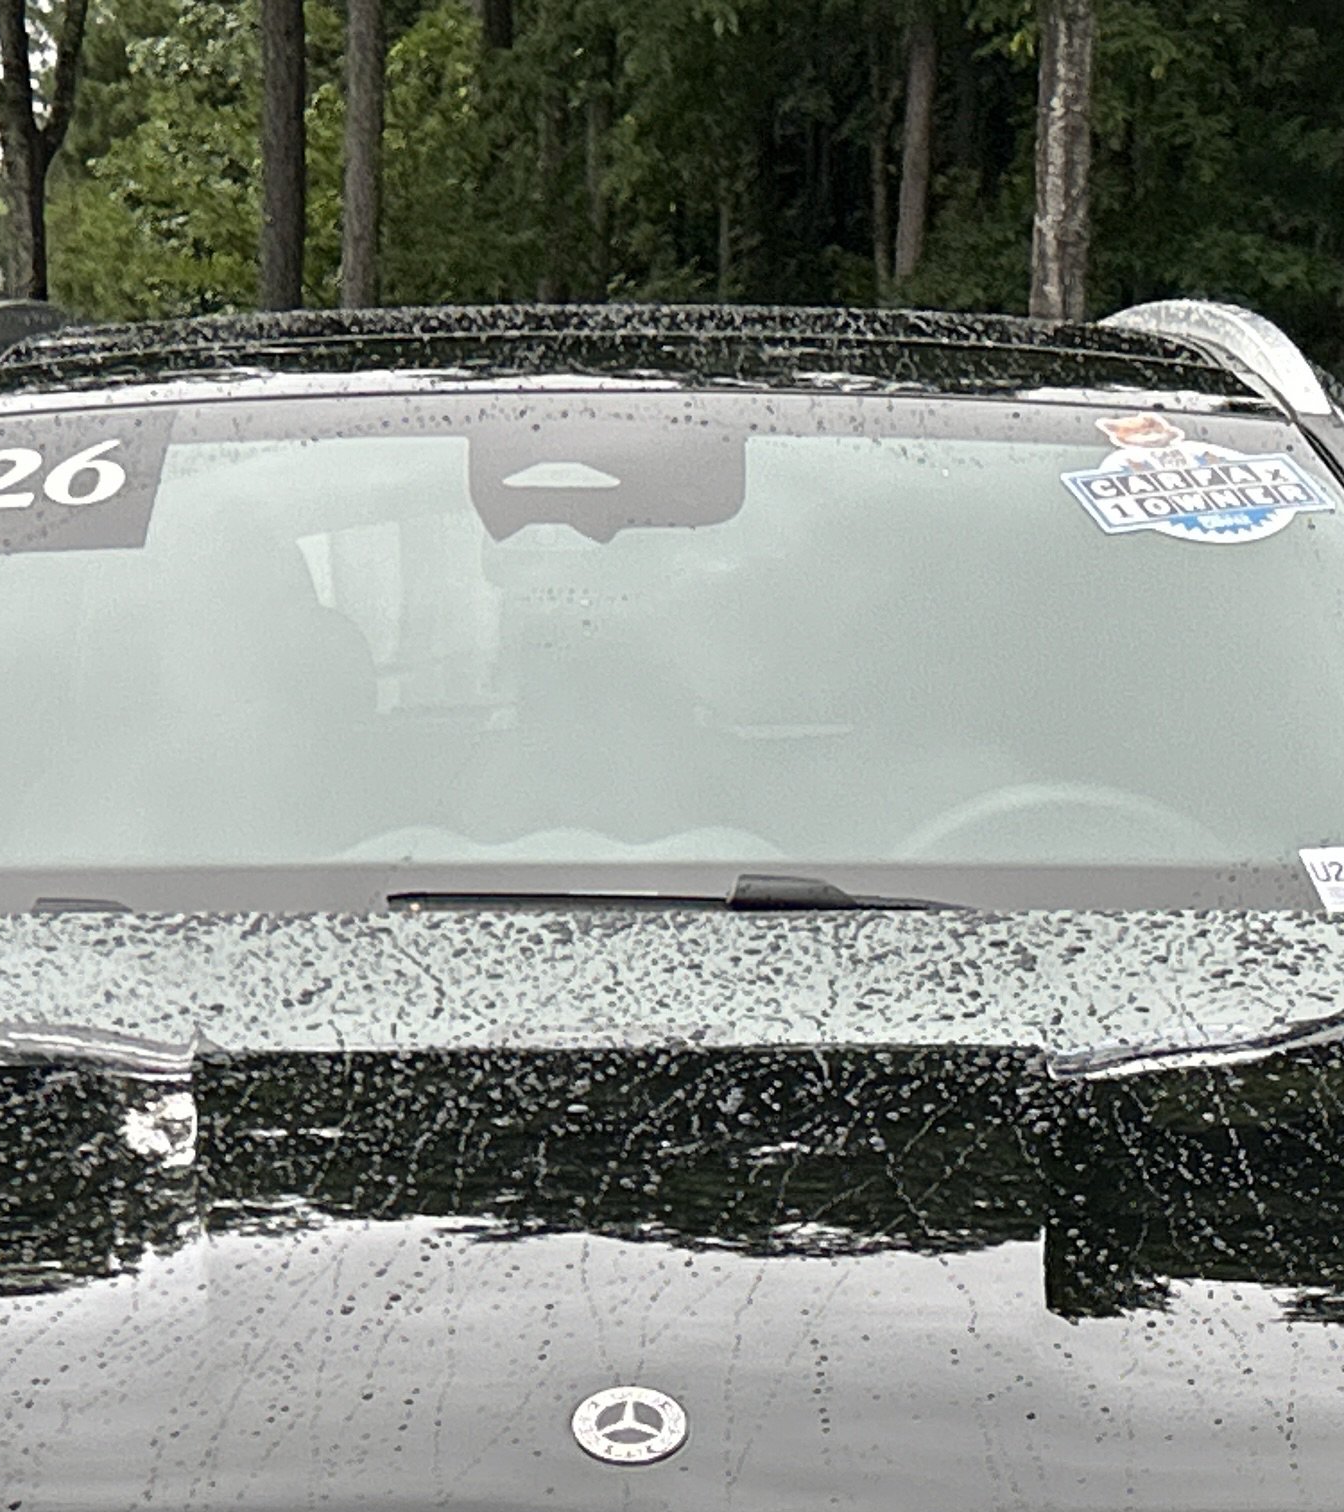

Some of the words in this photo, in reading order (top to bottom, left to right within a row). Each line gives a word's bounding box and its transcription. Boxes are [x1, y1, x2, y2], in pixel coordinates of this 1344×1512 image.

[1087, 465, 1290, 499] CARFAX
[1109, 502, 1134, 519] 1
[1142, 485, 1312, 516] OWNER
